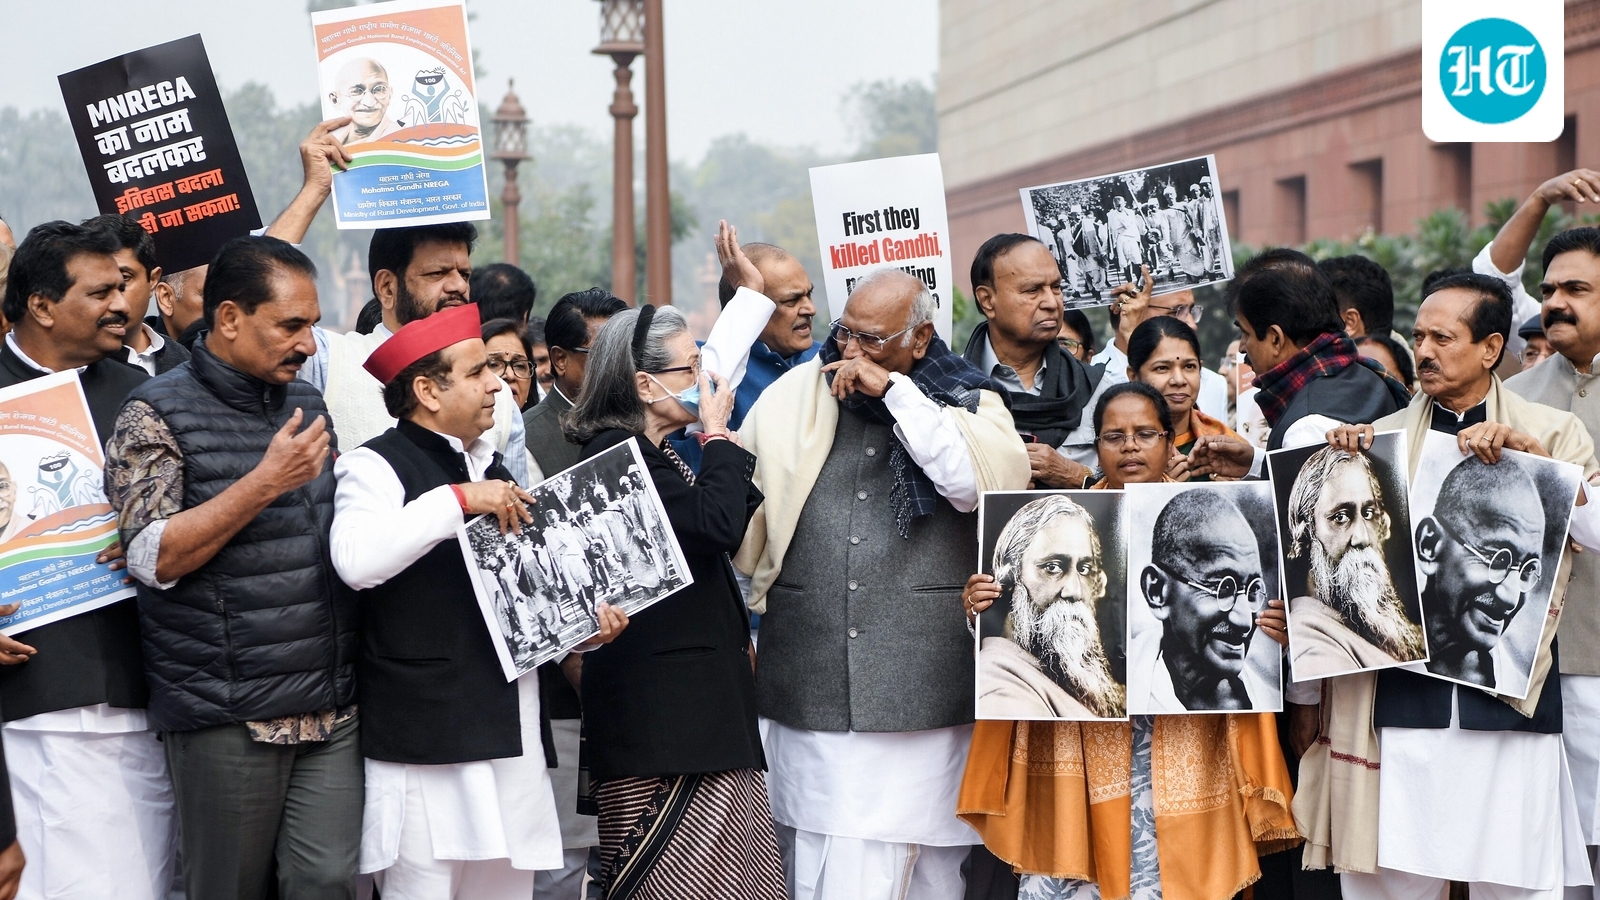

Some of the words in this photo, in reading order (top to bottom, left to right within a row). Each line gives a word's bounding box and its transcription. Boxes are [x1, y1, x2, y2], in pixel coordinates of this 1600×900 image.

[346, 34, 366, 44] Gandhi
[86, 75, 197, 128] MNREGA
[94, 125, 132, 156] का
[130, 107, 194, 144] नाम
[103, 135, 207, 184] बदलकर
[400, 171, 414, 181] गांधी
[114, 181, 176, 215] इतिहास
[174, 168, 225, 194] बदला
[361, 186, 395, 194] Mahatma
[396, 182, 422, 191] Gandhi
[423, 180, 450, 189] NREGA
[157, 208, 184, 228] जा
[183, 192, 240, 222] सकता!
[343, 210, 368, 219] Ministry
[377, 208, 395, 216] Rural
[396, 204, 441, 214] Development,
[842, 209, 883, 237] First
[883, 206, 920, 230] they
[829, 239, 881, 269] killed
[882, 232, 943, 262] Gandhi,
[49, 462, 62, 470] 100
[1, 583, 38, 599] Mahatma
[38, 571, 68, 586] Gandhi
[67, 563, 97, 577] NREGA
[14, 611, 22, 620] of
[22, 605, 43, 617] Rural
[112, 580, 120, 588] of
